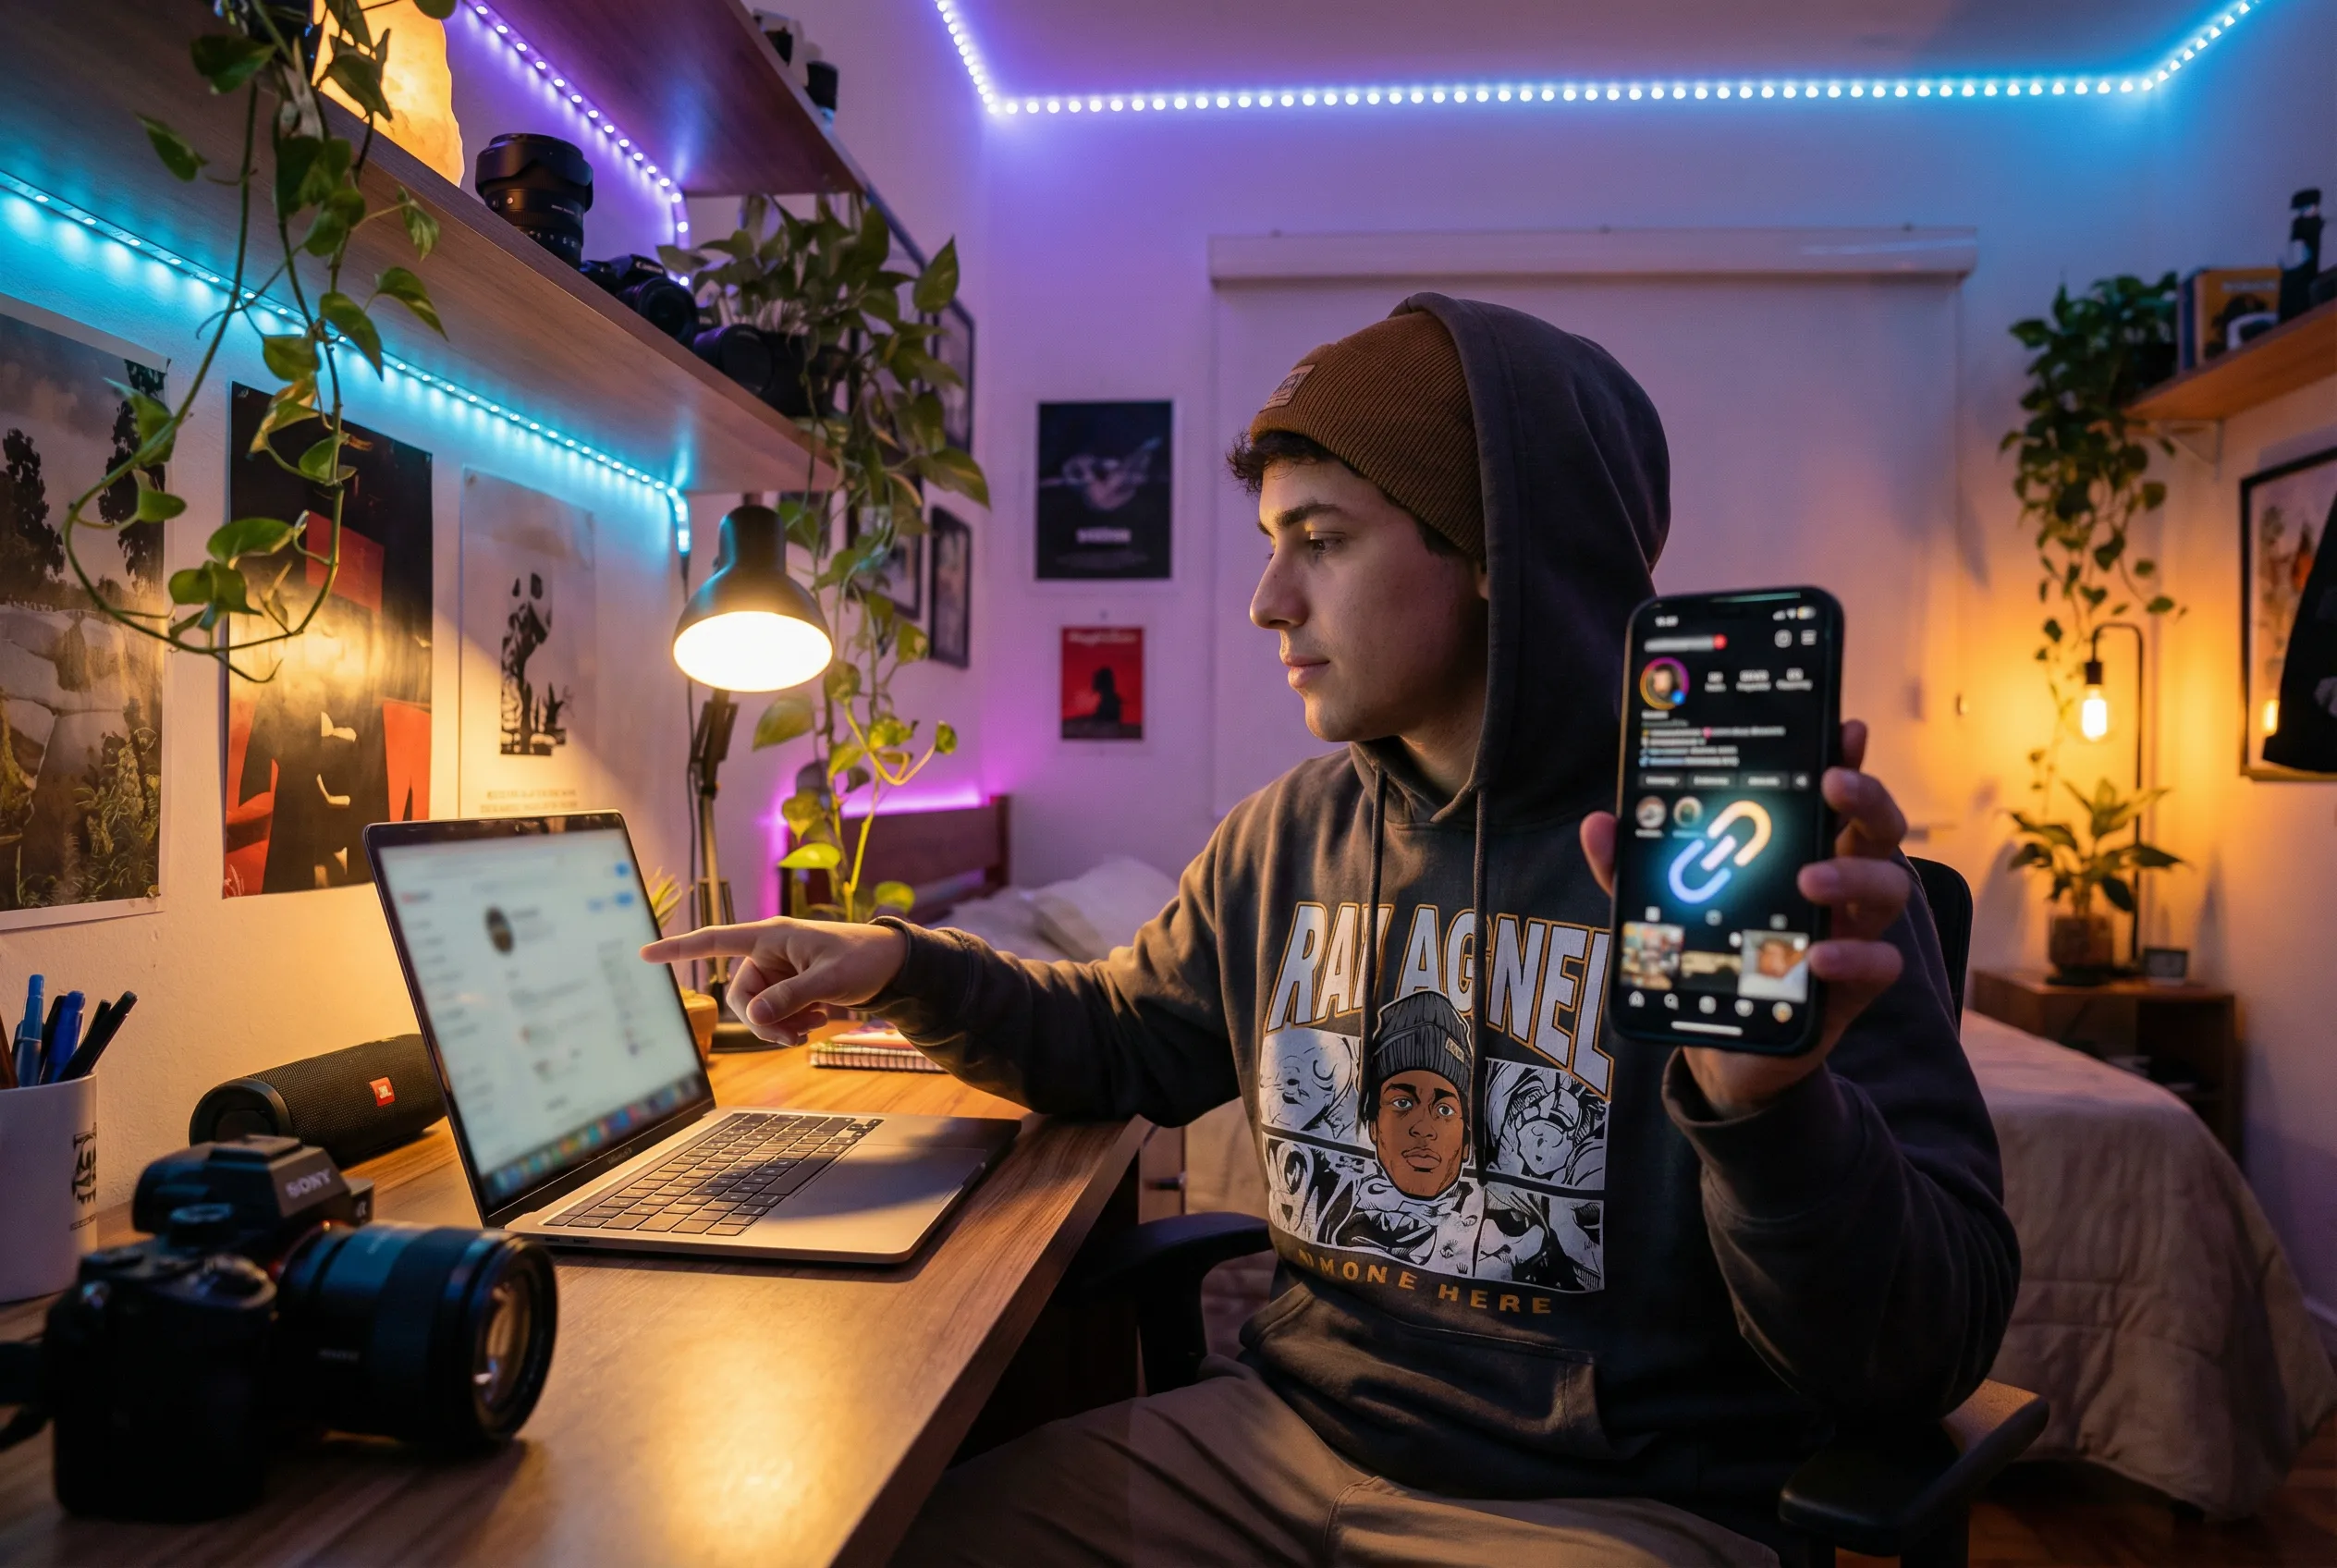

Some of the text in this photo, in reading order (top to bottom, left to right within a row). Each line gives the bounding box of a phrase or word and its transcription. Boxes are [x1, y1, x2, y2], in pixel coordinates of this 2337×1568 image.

[1264, 901, 1614, 1102] RAY AGNEL
[286, 1169, 331, 1198] SONY
[1438, 1283, 1552, 1314] HERE
